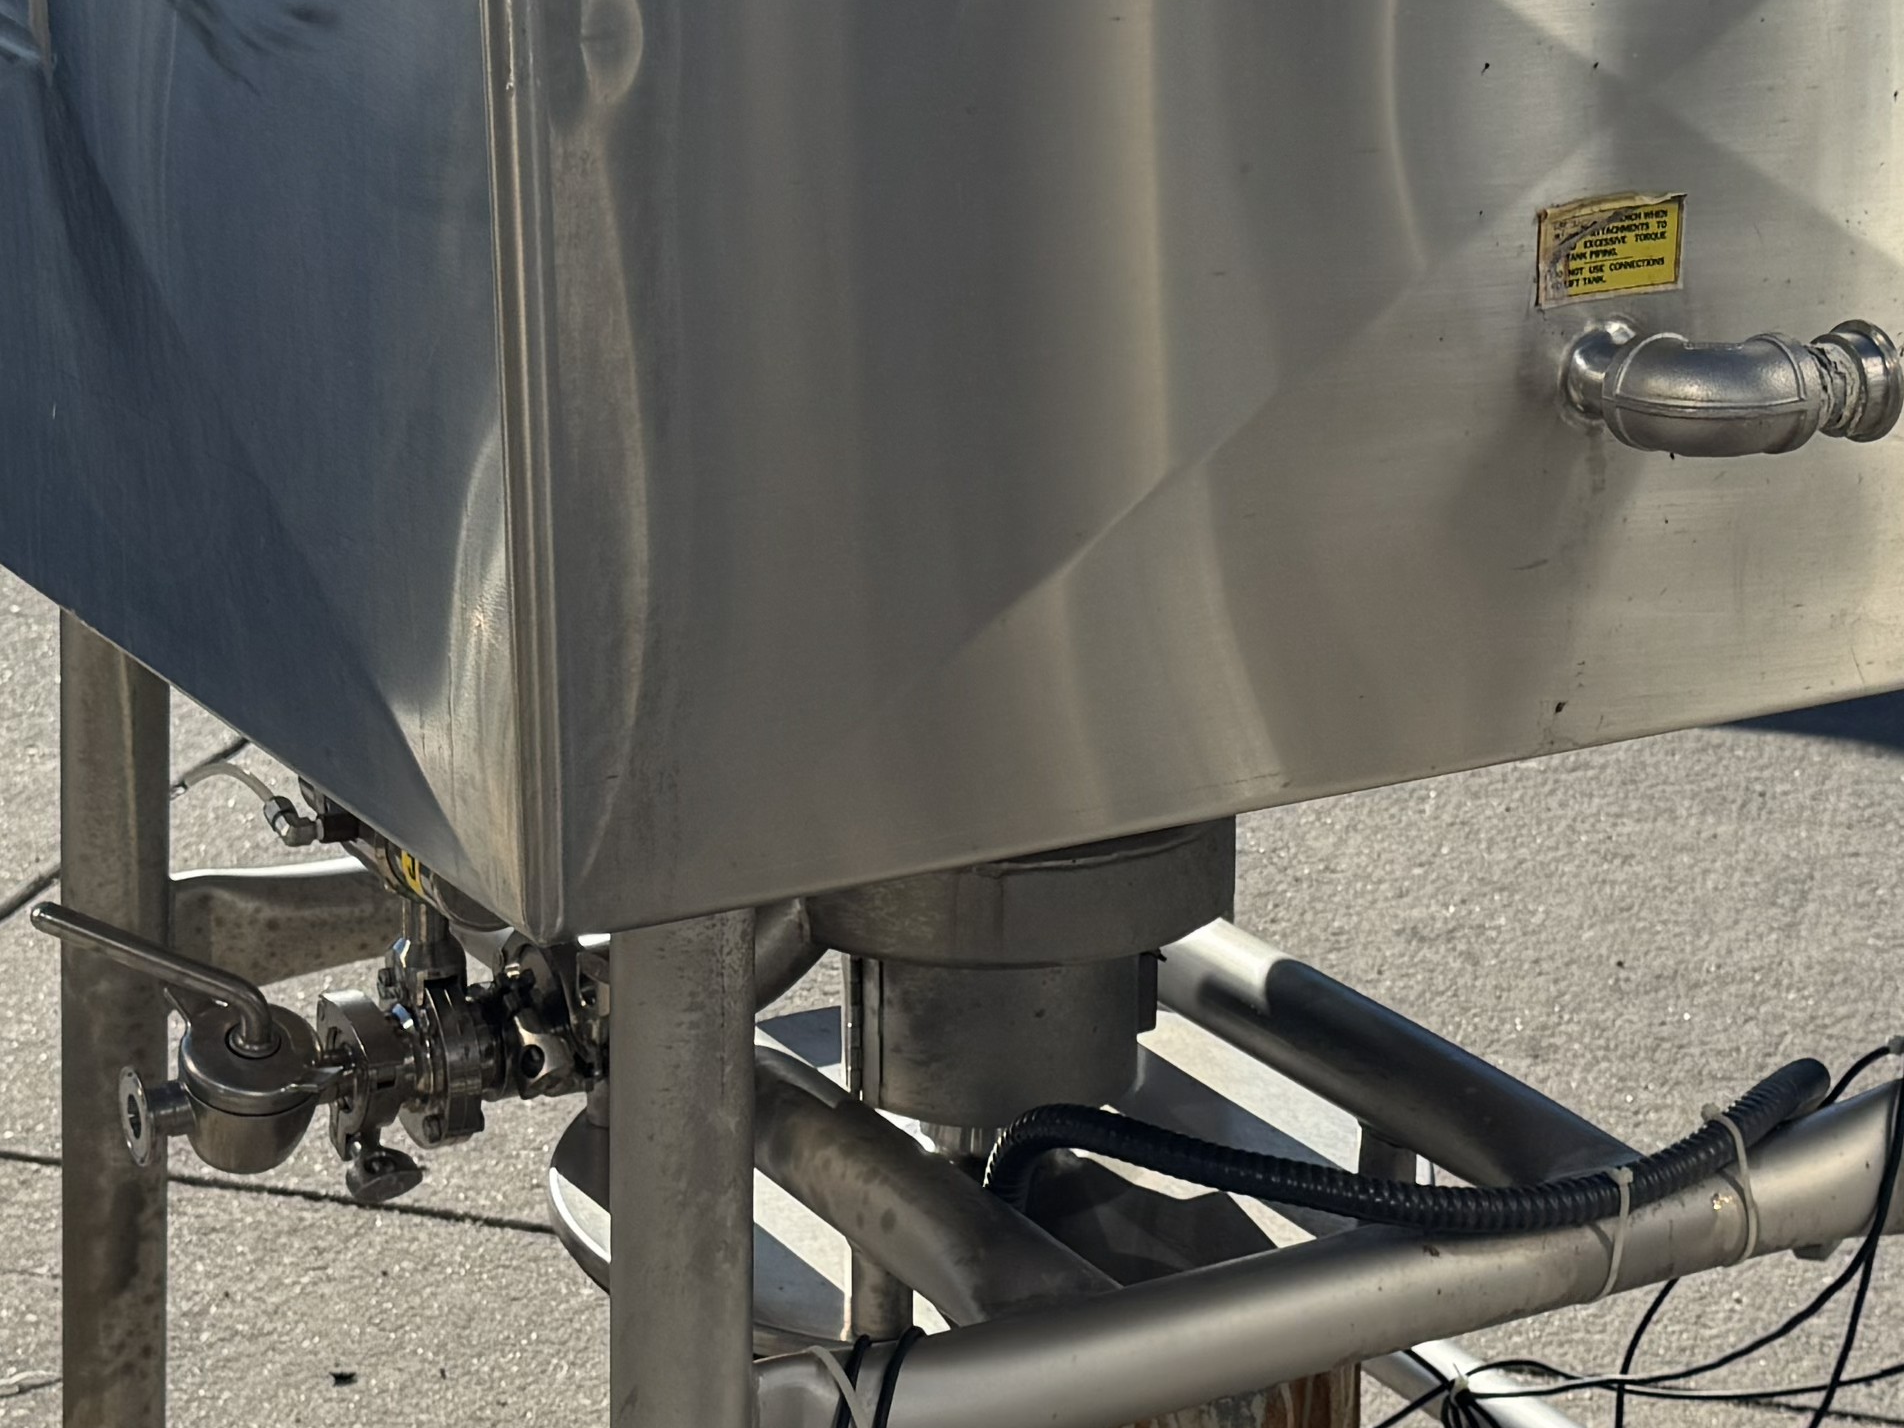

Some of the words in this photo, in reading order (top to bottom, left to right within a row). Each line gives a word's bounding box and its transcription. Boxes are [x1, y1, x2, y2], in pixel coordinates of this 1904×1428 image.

[1656, 220, 1667, 229] TO
[1584, 235, 1627, 249] EXCESSIVE
[1635, 231, 1667, 242] TORQUE
[1589, 263, 1605, 274] USE
[1609, 257, 1665, 271] CONNECTIONS
